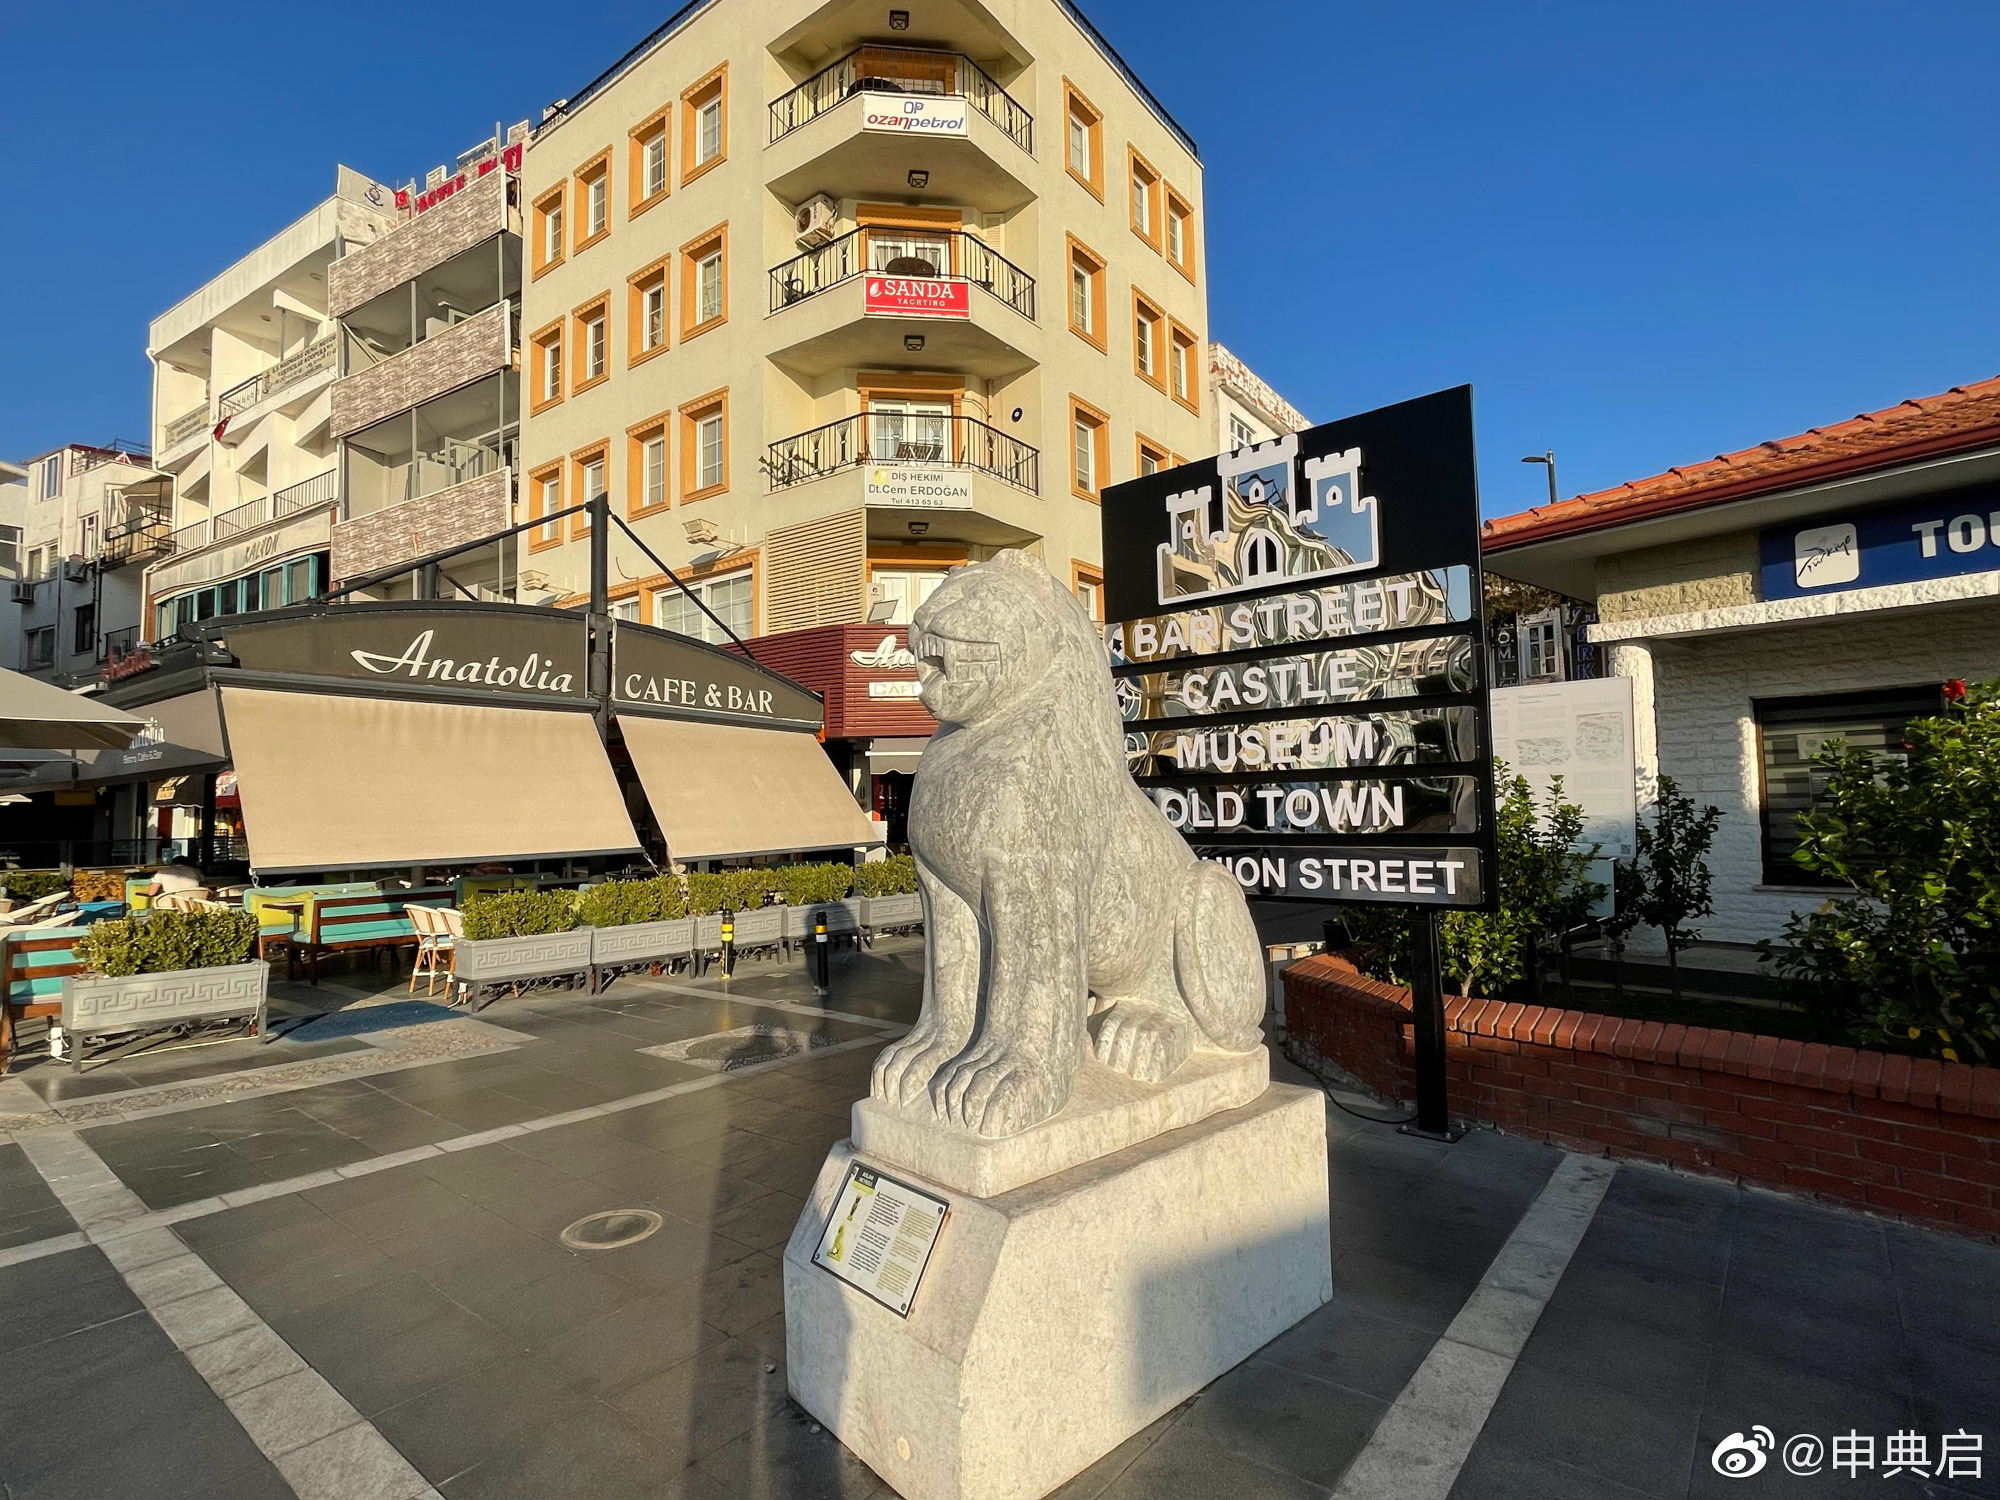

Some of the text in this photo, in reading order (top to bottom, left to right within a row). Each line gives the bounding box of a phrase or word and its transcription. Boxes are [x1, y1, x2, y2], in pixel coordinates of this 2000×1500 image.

[867, 114, 964, 130] ozanpetrol
[903, 101, 924, 114] OP
[884, 280, 955, 299] SANDA
[897, 298, 946, 307] YACHTING
[868, 484, 968, 497] Dt.Cem ERDOĞAN
[1911, 511, 2000, 558] TO
[1134, 580, 1417, 657] BAR STREET
[350, 629, 573, 692] Anatolia
[624, 673, 774, 714] CAFE & BAR
[1182, 656, 1359, 709] CASTLE
[1177, 721, 1373, 768] MUSEUM
[1161, 786, 1404, 828] OLD TOWN
[1299, 858, 1465, 895] STREET
